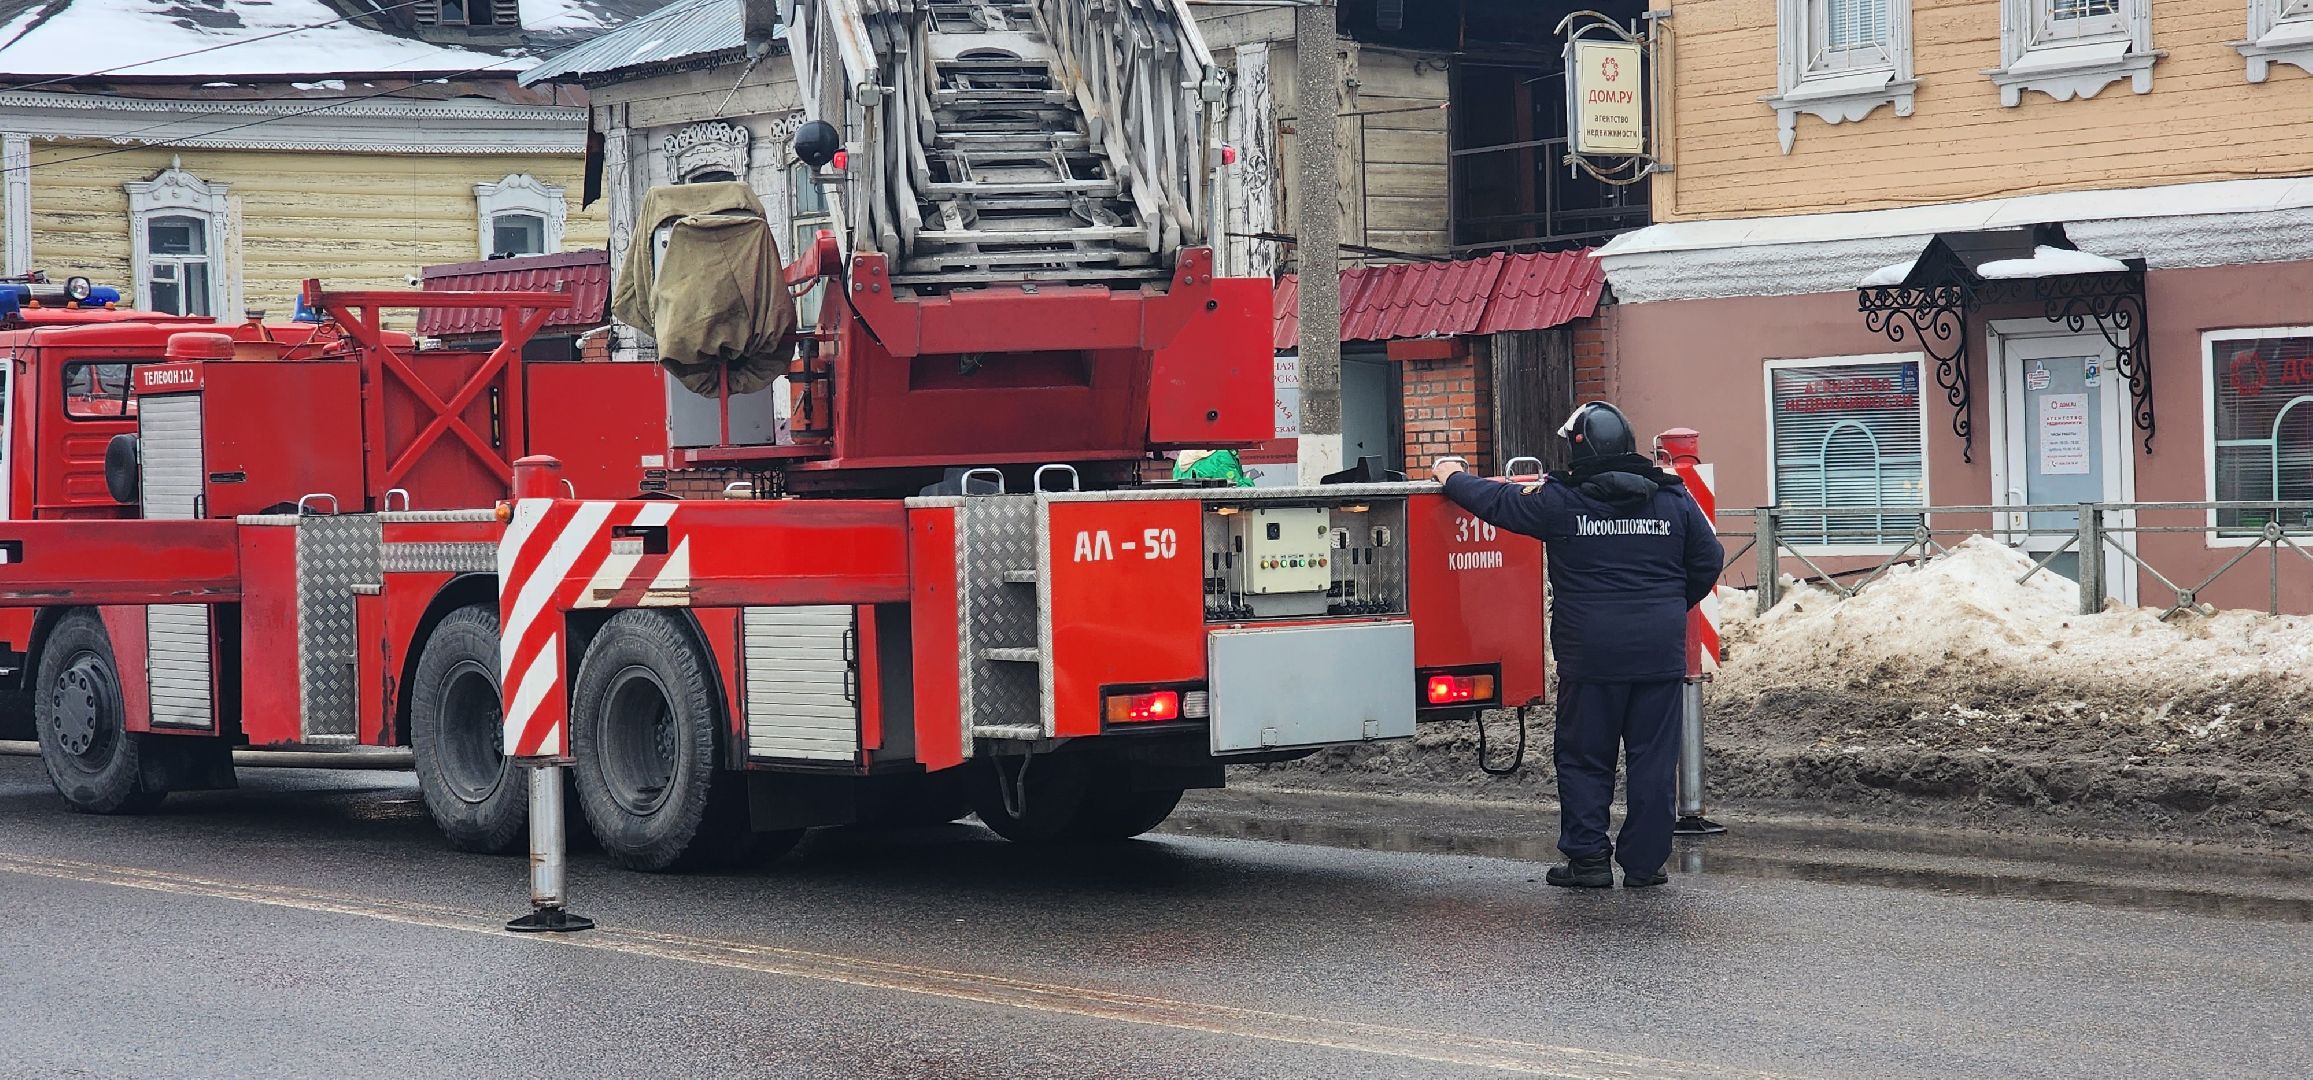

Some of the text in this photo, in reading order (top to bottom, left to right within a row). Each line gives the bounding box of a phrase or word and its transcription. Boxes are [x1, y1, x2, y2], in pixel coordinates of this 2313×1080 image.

[1588, 89, 1633, 104] ДОМ.РУ
[1594, 114, 1629, 124] агентство
[1586, 128, 1638, 138] недвижимости
[143, 368, 195, 386] ТЕЛЕФОН 112
[1804, 377, 1891, 394] АГЕНТСТВО
[1784, 394, 1913, 413] НЕДВИЖИМОСТИ
[1455, 515, 1497, 543] 316
[1575, 513, 1671, 537] Мособлпожспас
[1073, 530, 1114, 562] АЛ
[1143, 528, 1177, 560] 50
[1448, 550, 1503, 571] КОЛОМНА
